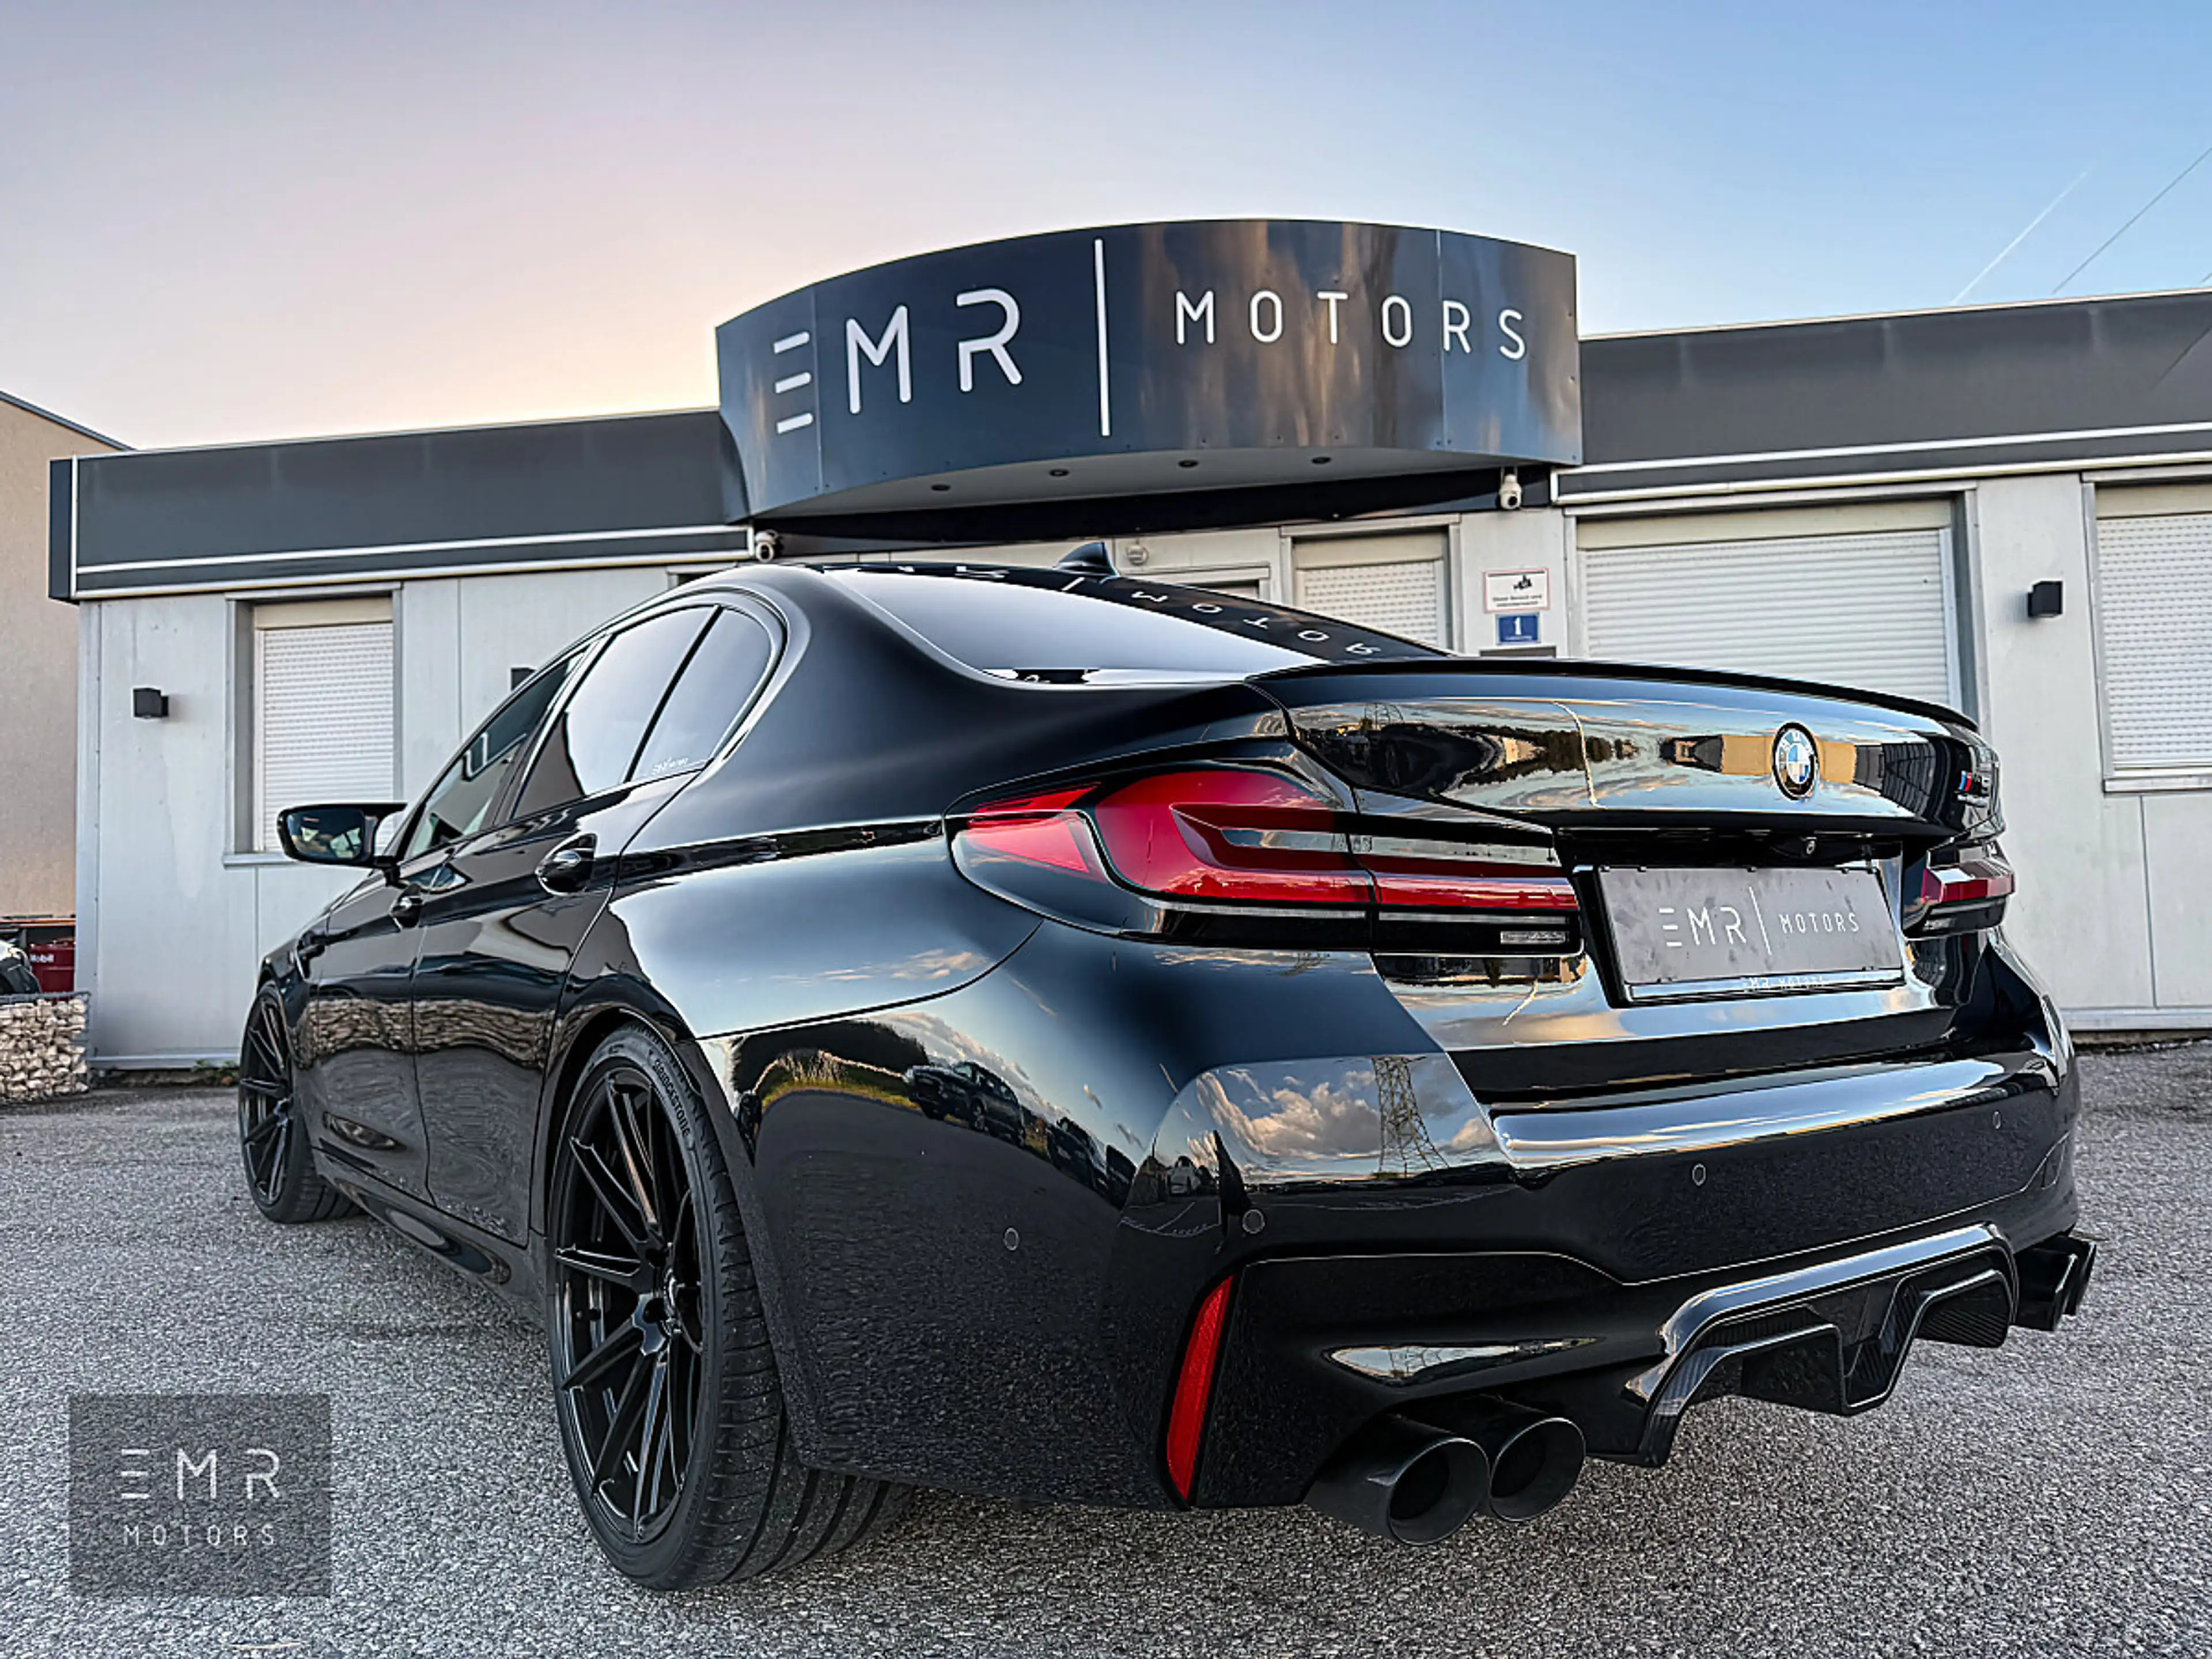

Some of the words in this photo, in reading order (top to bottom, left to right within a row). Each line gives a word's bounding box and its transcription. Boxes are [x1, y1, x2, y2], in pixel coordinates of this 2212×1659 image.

[773, 287, 1022, 434] EMR
[1175, 290, 1526, 360] MOTORS
[1514, 617, 1522, 635] 1
[1658, 906, 1747, 946] EMR
[1778, 912, 1859, 934] MOTORS
